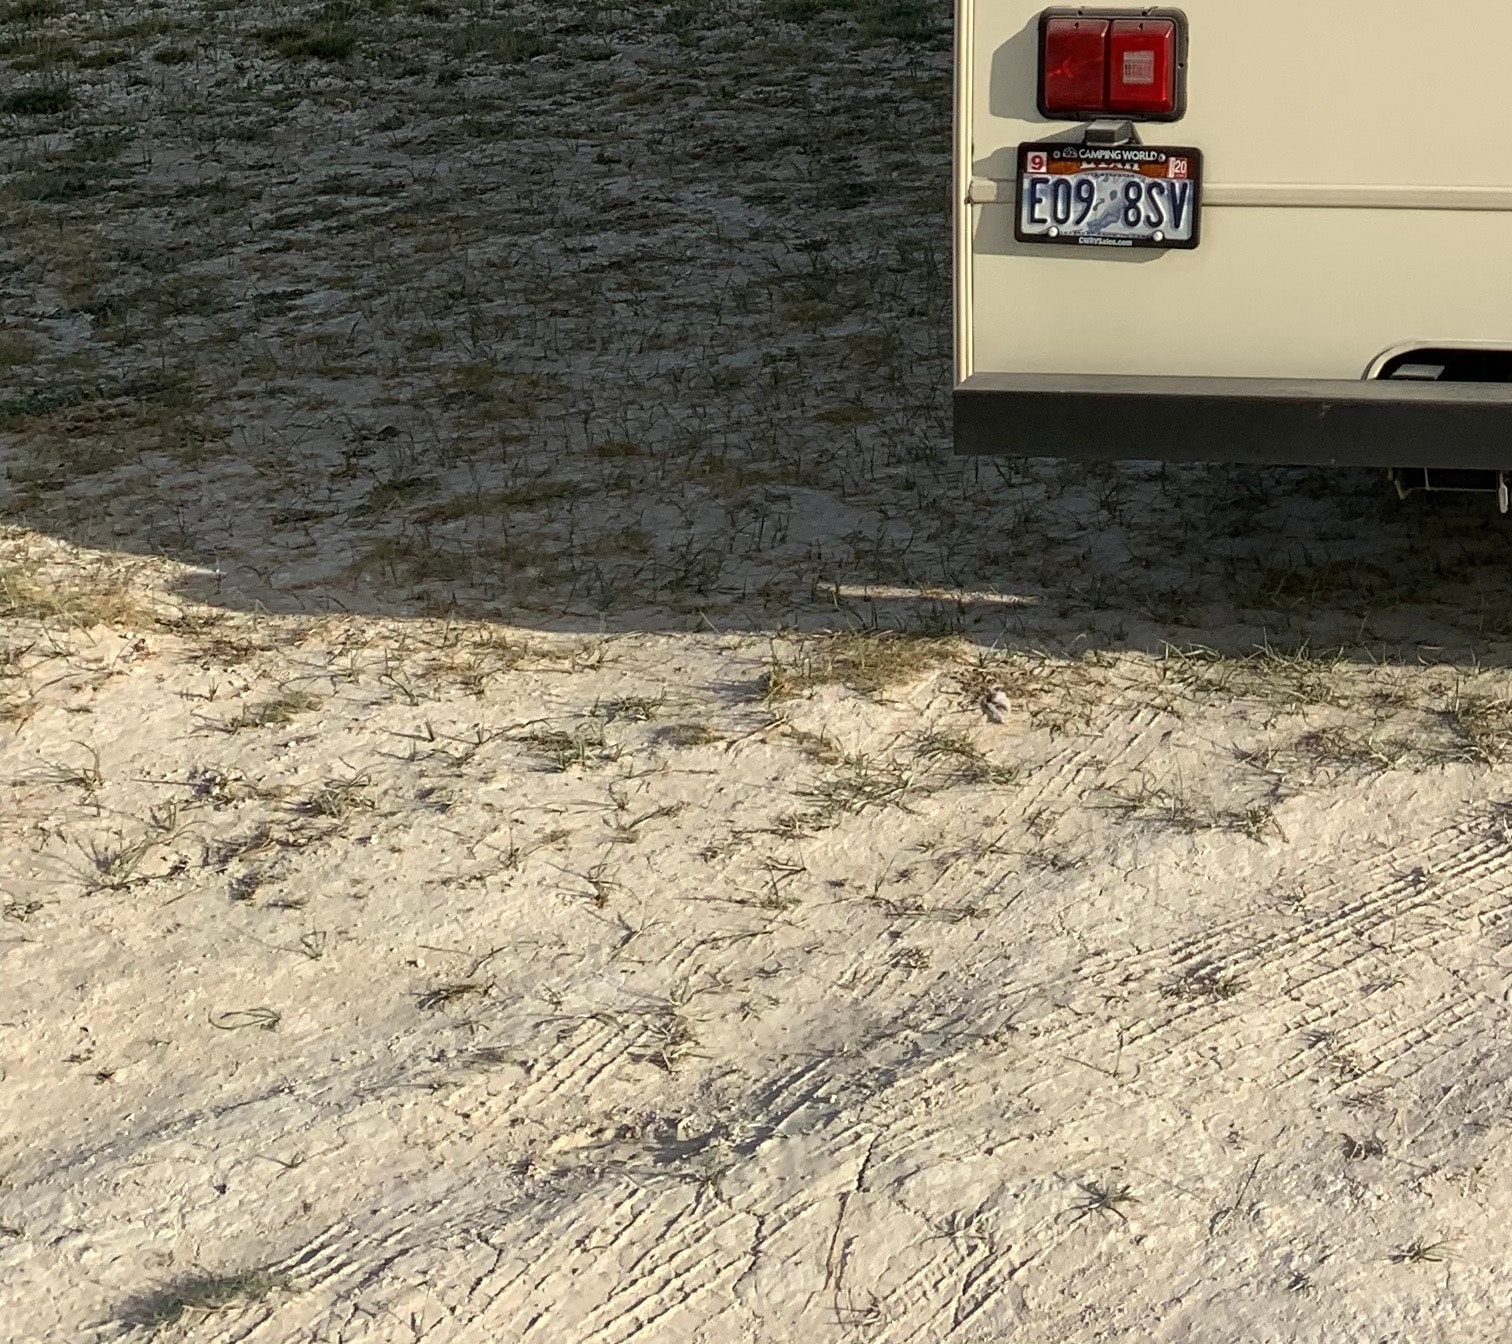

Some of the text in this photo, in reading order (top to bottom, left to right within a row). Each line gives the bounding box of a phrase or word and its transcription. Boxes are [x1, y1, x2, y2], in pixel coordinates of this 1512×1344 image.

[1078, 149, 1158, 161] CAMPING WORLD
[1031, 155, 1044, 170] 9
[1174, 160, 1187, 174] 20
